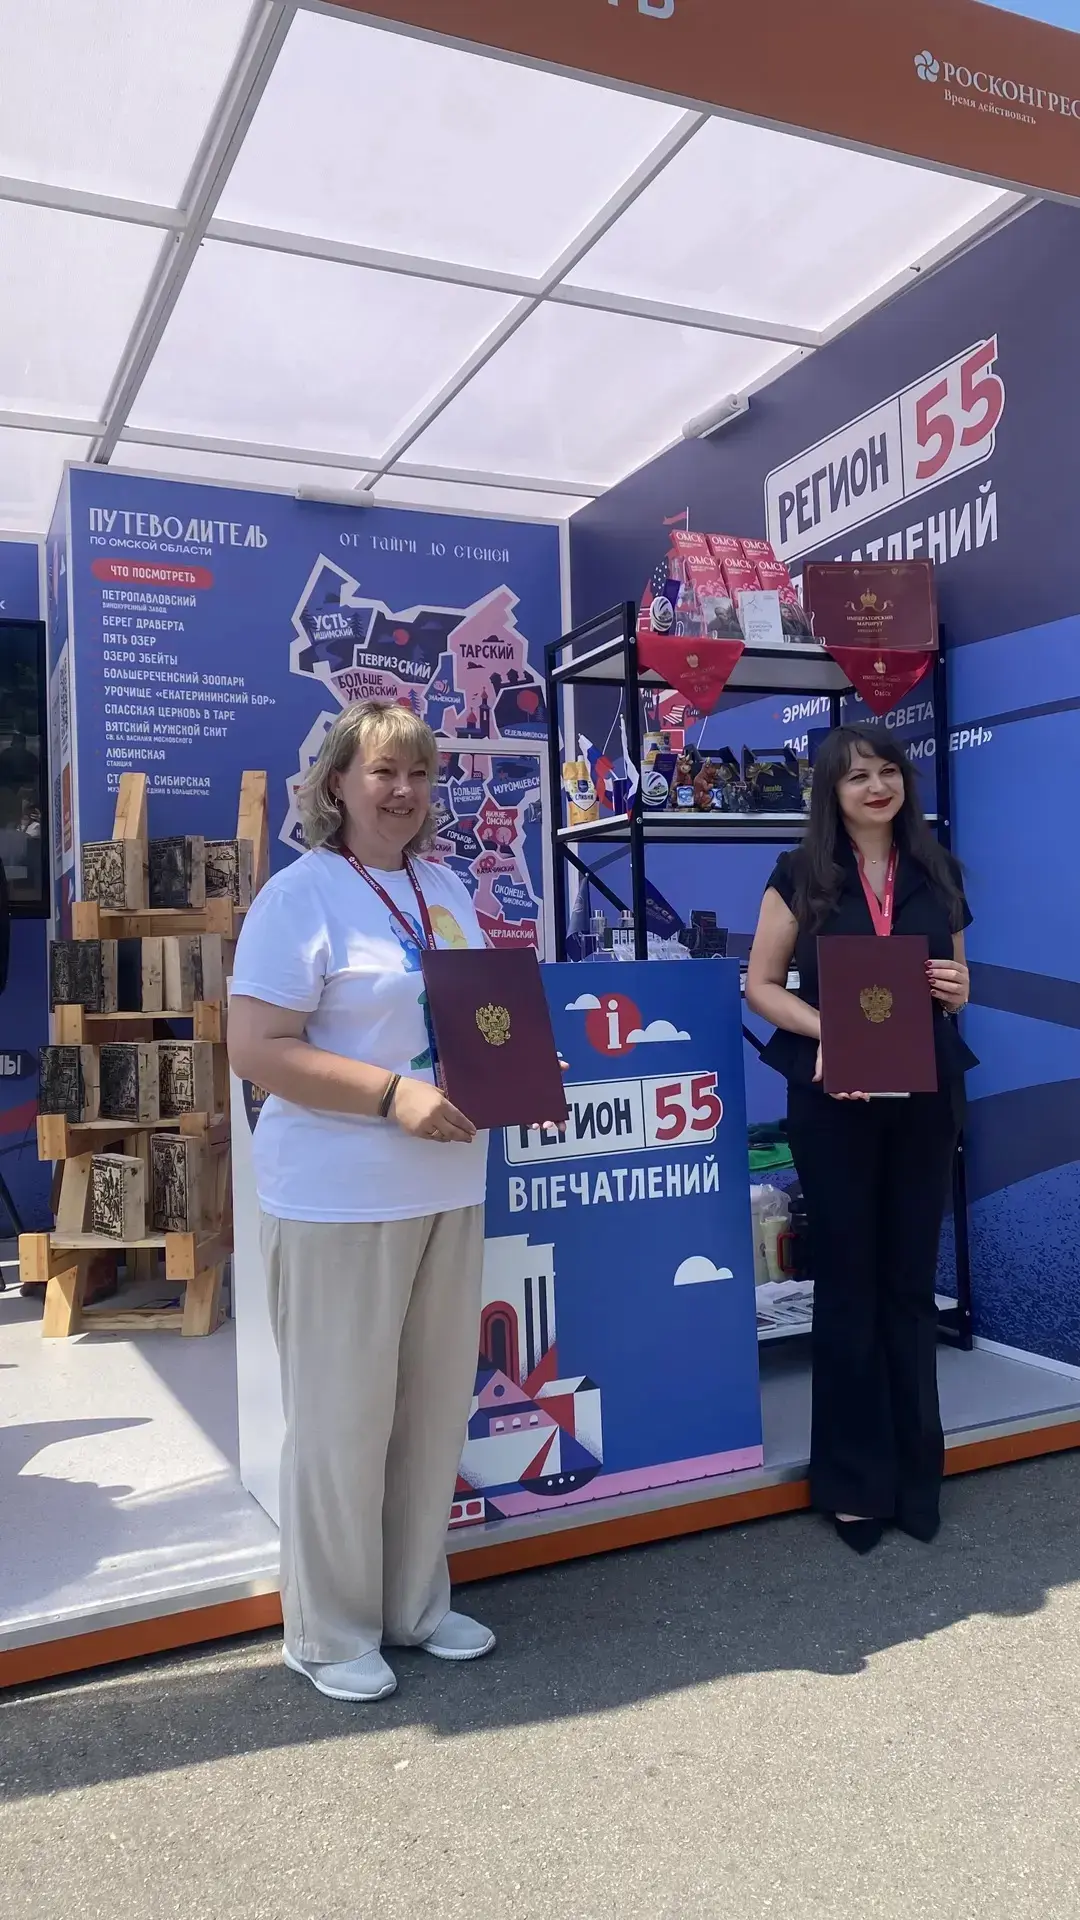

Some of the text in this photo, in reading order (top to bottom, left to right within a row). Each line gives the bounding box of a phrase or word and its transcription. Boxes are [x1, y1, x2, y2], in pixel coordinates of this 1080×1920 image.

[944, 88, 1037, 125] Время действовать
[778, 338, 1003, 545] РЕГИОН 55
[89, 507, 267, 548] ПУТЕВОДИТЕЛЬ
[90, 536, 212, 556] ПО ОМСКОЙ ОБЛАСТИ
[339, 532, 360, 547] ОТ
[676, 532, 703, 543] ОМСК
[712, 536, 738, 547] ОМСК
[744, 540, 769, 550] ОМСК
[688, 555, 716, 566] ОМСК
[725, 558, 752, 569] ОМСК
[759, 561, 785, 572] ОМСК
[110, 565, 196, 583] ЧТО ПОСМОТРЕТЬ
[102, 589, 197, 607] ПЕТРОПАВЛОВСКИЙ
[102, 616, 185, 631] БЕРЕГ ДРАВЕРТА
[313, 612, 352, 631] УСТЬ-
[103, 633, 156, 646] ПЯТЬ ОЗЕР
[313, 627, 354, 641] ИШИМСКИЙ
[103, 650, 178, 665] ОЗЕРО ЭБЕЙТЫ
[459, 643, 515, 661] ТАРСКИЙ
[359, 652, 432, 679] ТЕВРИЗСКИЙ
[104, 668, 245, 686] БОЛЬШЕРЕЧЕНСКИЙ ЗООПАРК
[338, 672, 383, 689] БОЛЬШЕ
[104, 685, 276, 705] УРОЧИЩЕ «ЕКАТЕРИНИНСКИЙ БОР»
[347, 684, 398, 701] УКОВСКИЙ
[104, 703, 236, 720] СПАССКАЯ ЦЕРКОВЬ В ТАРЕ
[885, 701, 935, 729] СВЕТА
[105, 720, 228, 737] ВЯТСКИЙ МУЖСКОЙ СКИТ
[106, 748, 165, 760] ЛЮБИНСКАЯ
[154, 775, 211, 787] СИБИРСКАЯ
[453, 786, 484, 797] БОЛЬШЕ-
[486, 817, 513, 826] ОМСКИЙ
[494, 884, 526, 898] ОКОНЕШ-
[488, 928, 535, 939] ЧЕРЛАКСКИЙ
[655, 1074, 722, 1141] 55
[508, 1154, 720, 1213] ВПЕЧАТЛЕНИЙ
